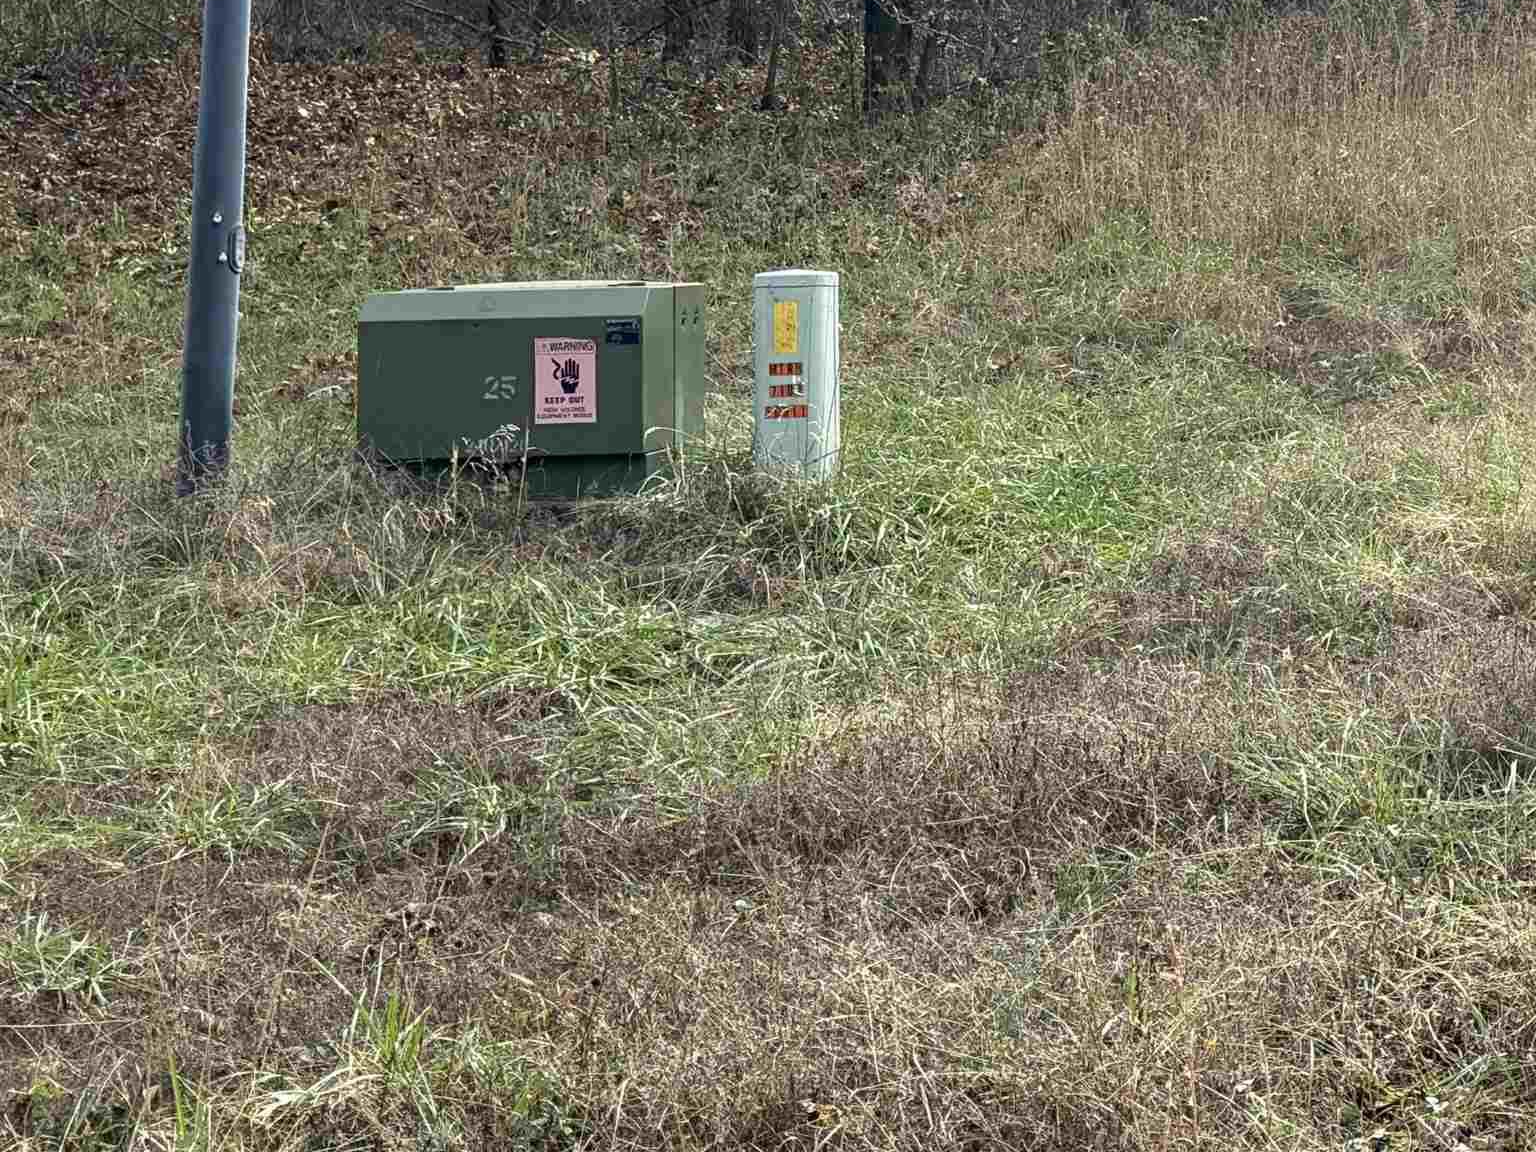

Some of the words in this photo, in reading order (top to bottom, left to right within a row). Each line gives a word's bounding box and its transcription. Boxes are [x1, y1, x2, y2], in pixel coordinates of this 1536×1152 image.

[550, 341, 593, 352] WARNING
[483, 375, 517, 399] 25
[544, 396, 566, 405] KEEP
[568, 395, 585, 404] OUT
